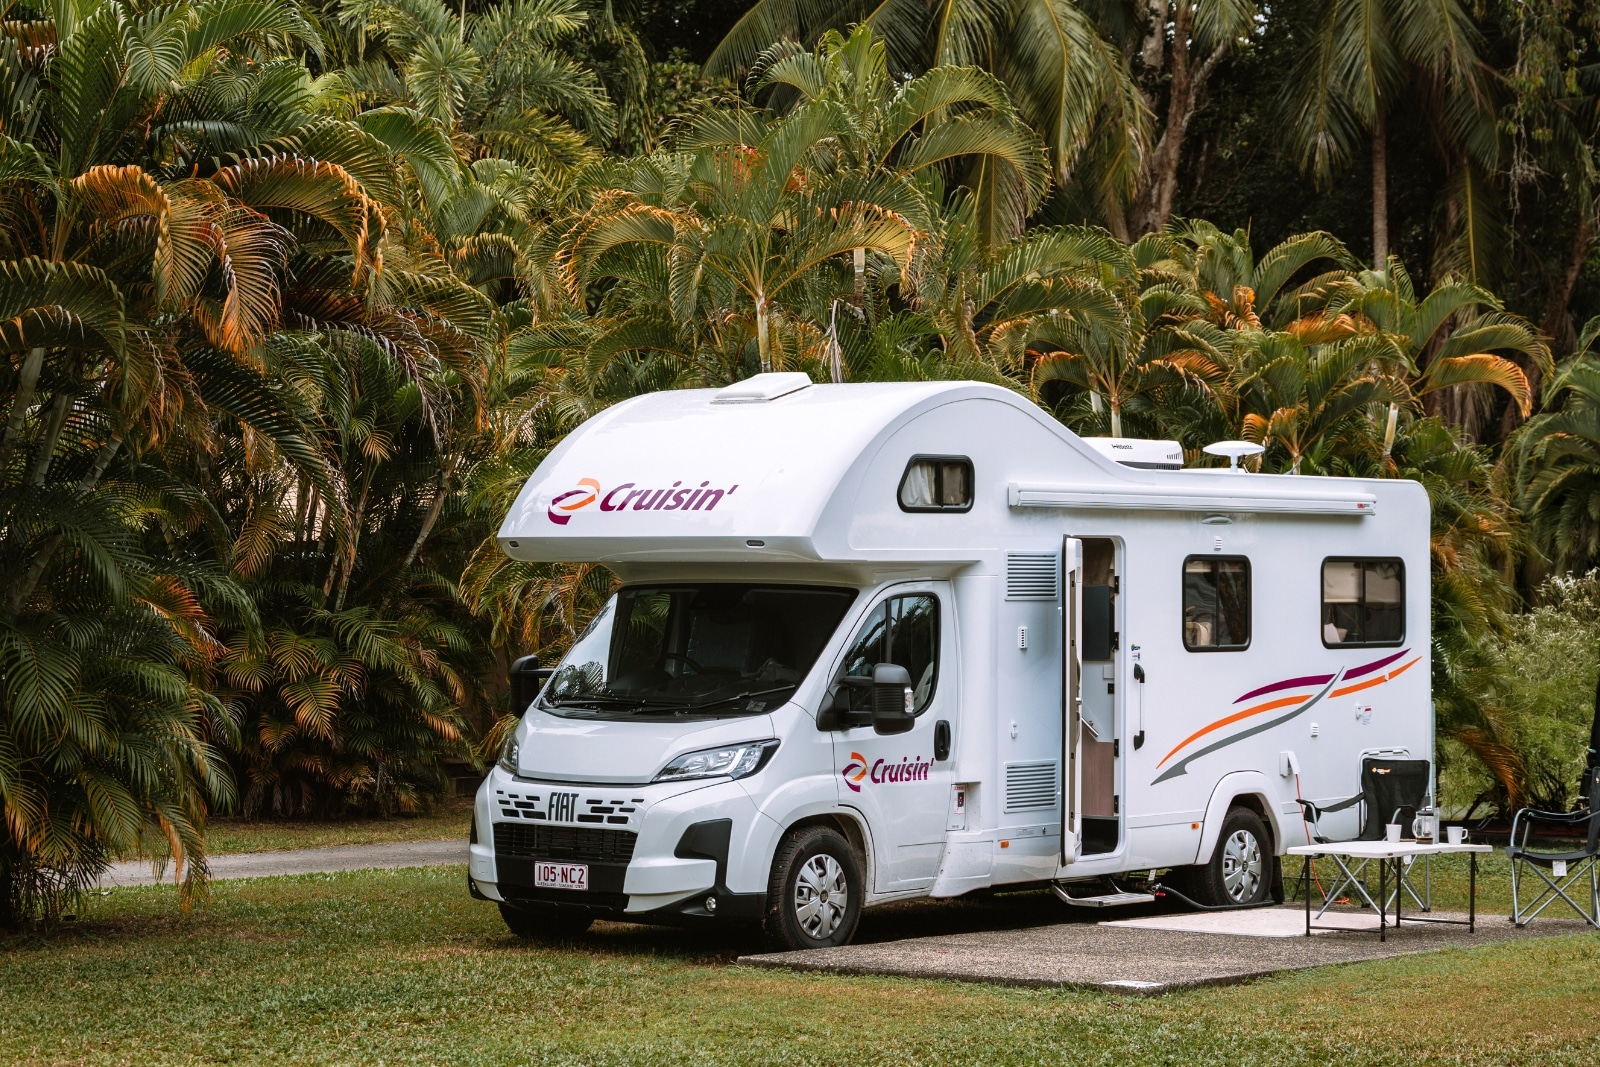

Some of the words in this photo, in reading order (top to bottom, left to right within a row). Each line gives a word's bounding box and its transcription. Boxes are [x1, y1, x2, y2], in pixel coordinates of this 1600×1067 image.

[600, 481, 739, 512] Cruisin'
[870, 755, 934, 784] Cruisin'
[548, 792, 580, 822] FIAT
